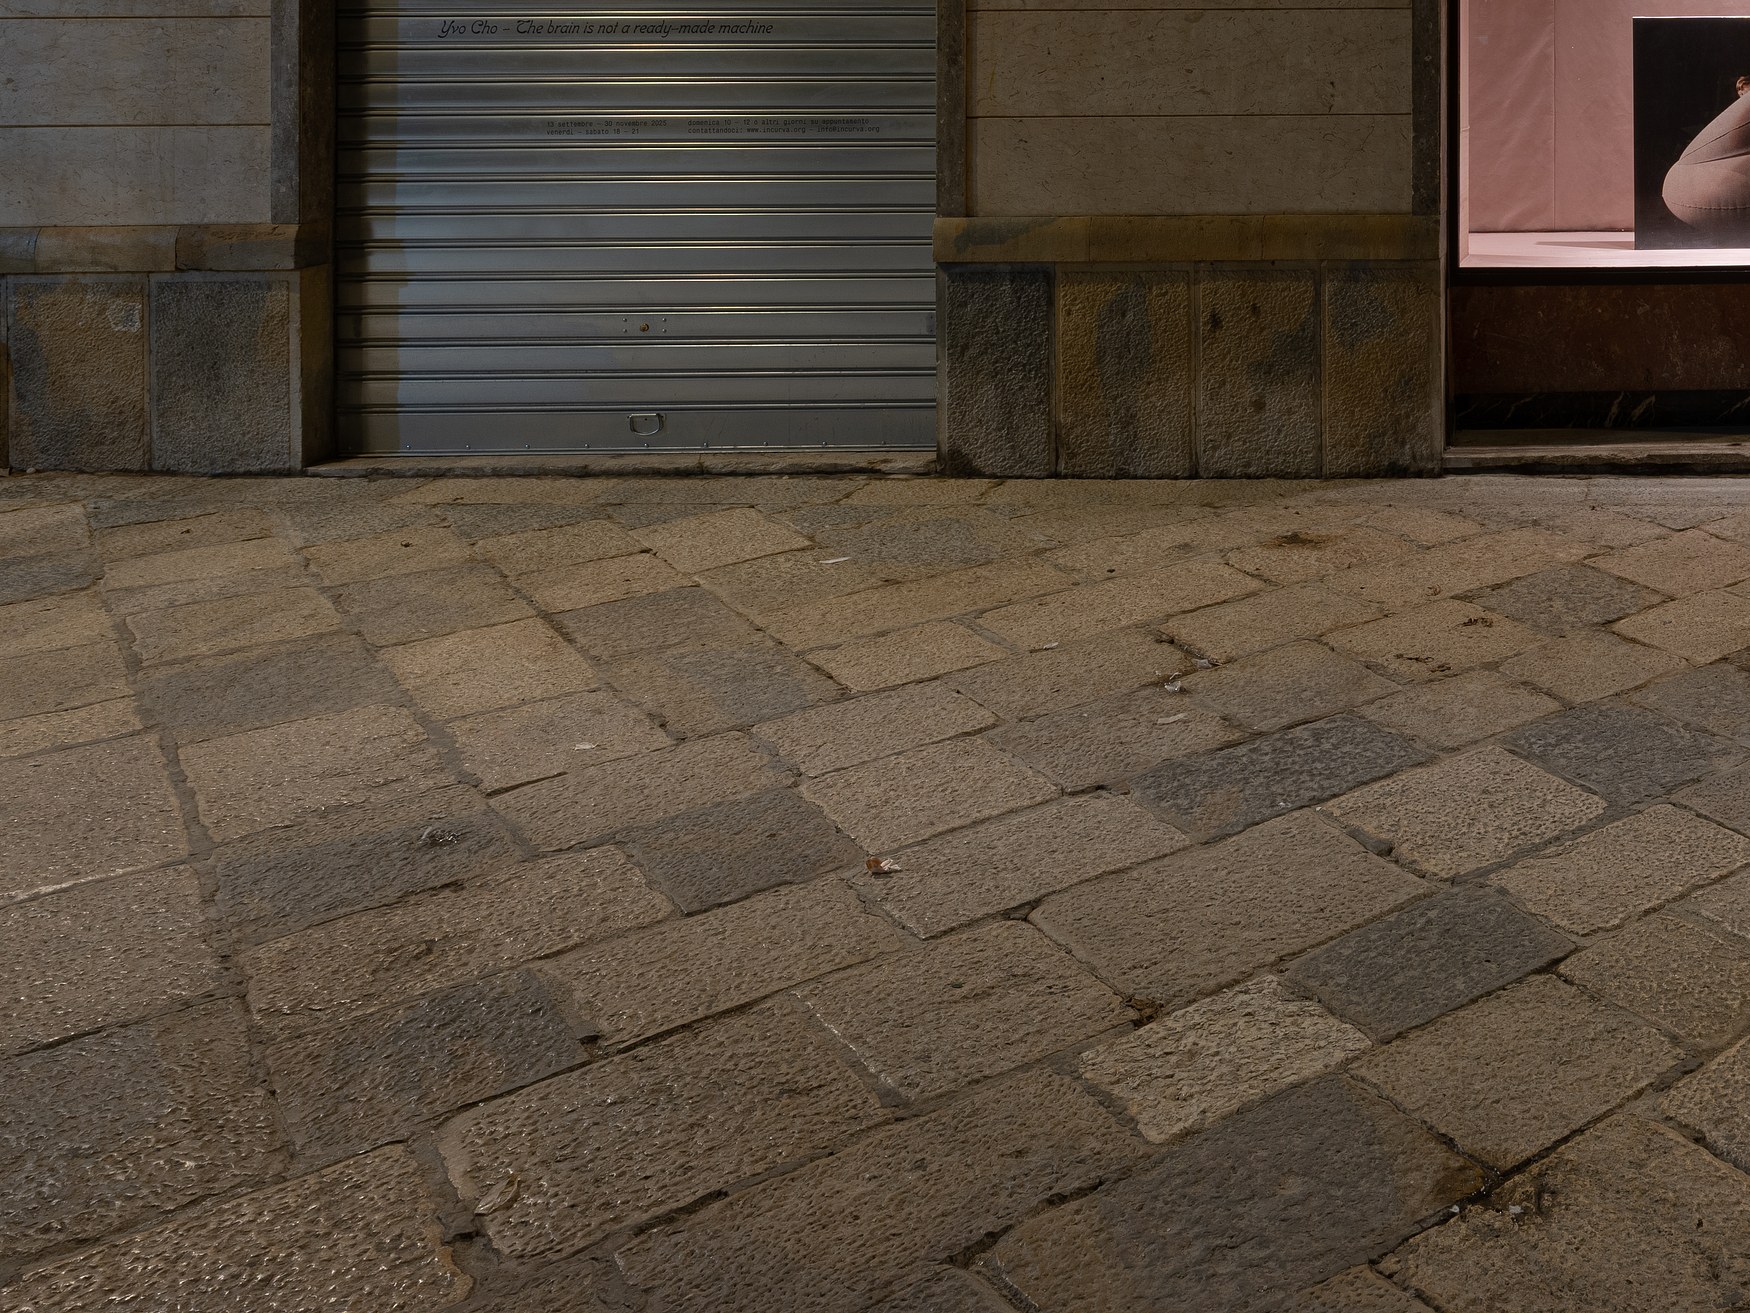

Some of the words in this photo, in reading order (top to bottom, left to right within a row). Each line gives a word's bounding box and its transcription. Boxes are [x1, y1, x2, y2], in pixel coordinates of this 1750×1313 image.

[437, 20, 466, 38] Yvo
[471, 20, 498, 34] Cho
[516, 20, 542, 34] The
[547, 20, 580, 34] brain
[583, 22, 594, 34] is
[597, 22, 619, 34] not
[621, 25, 630, 34] a
[718, 20, 774, 34] machine
